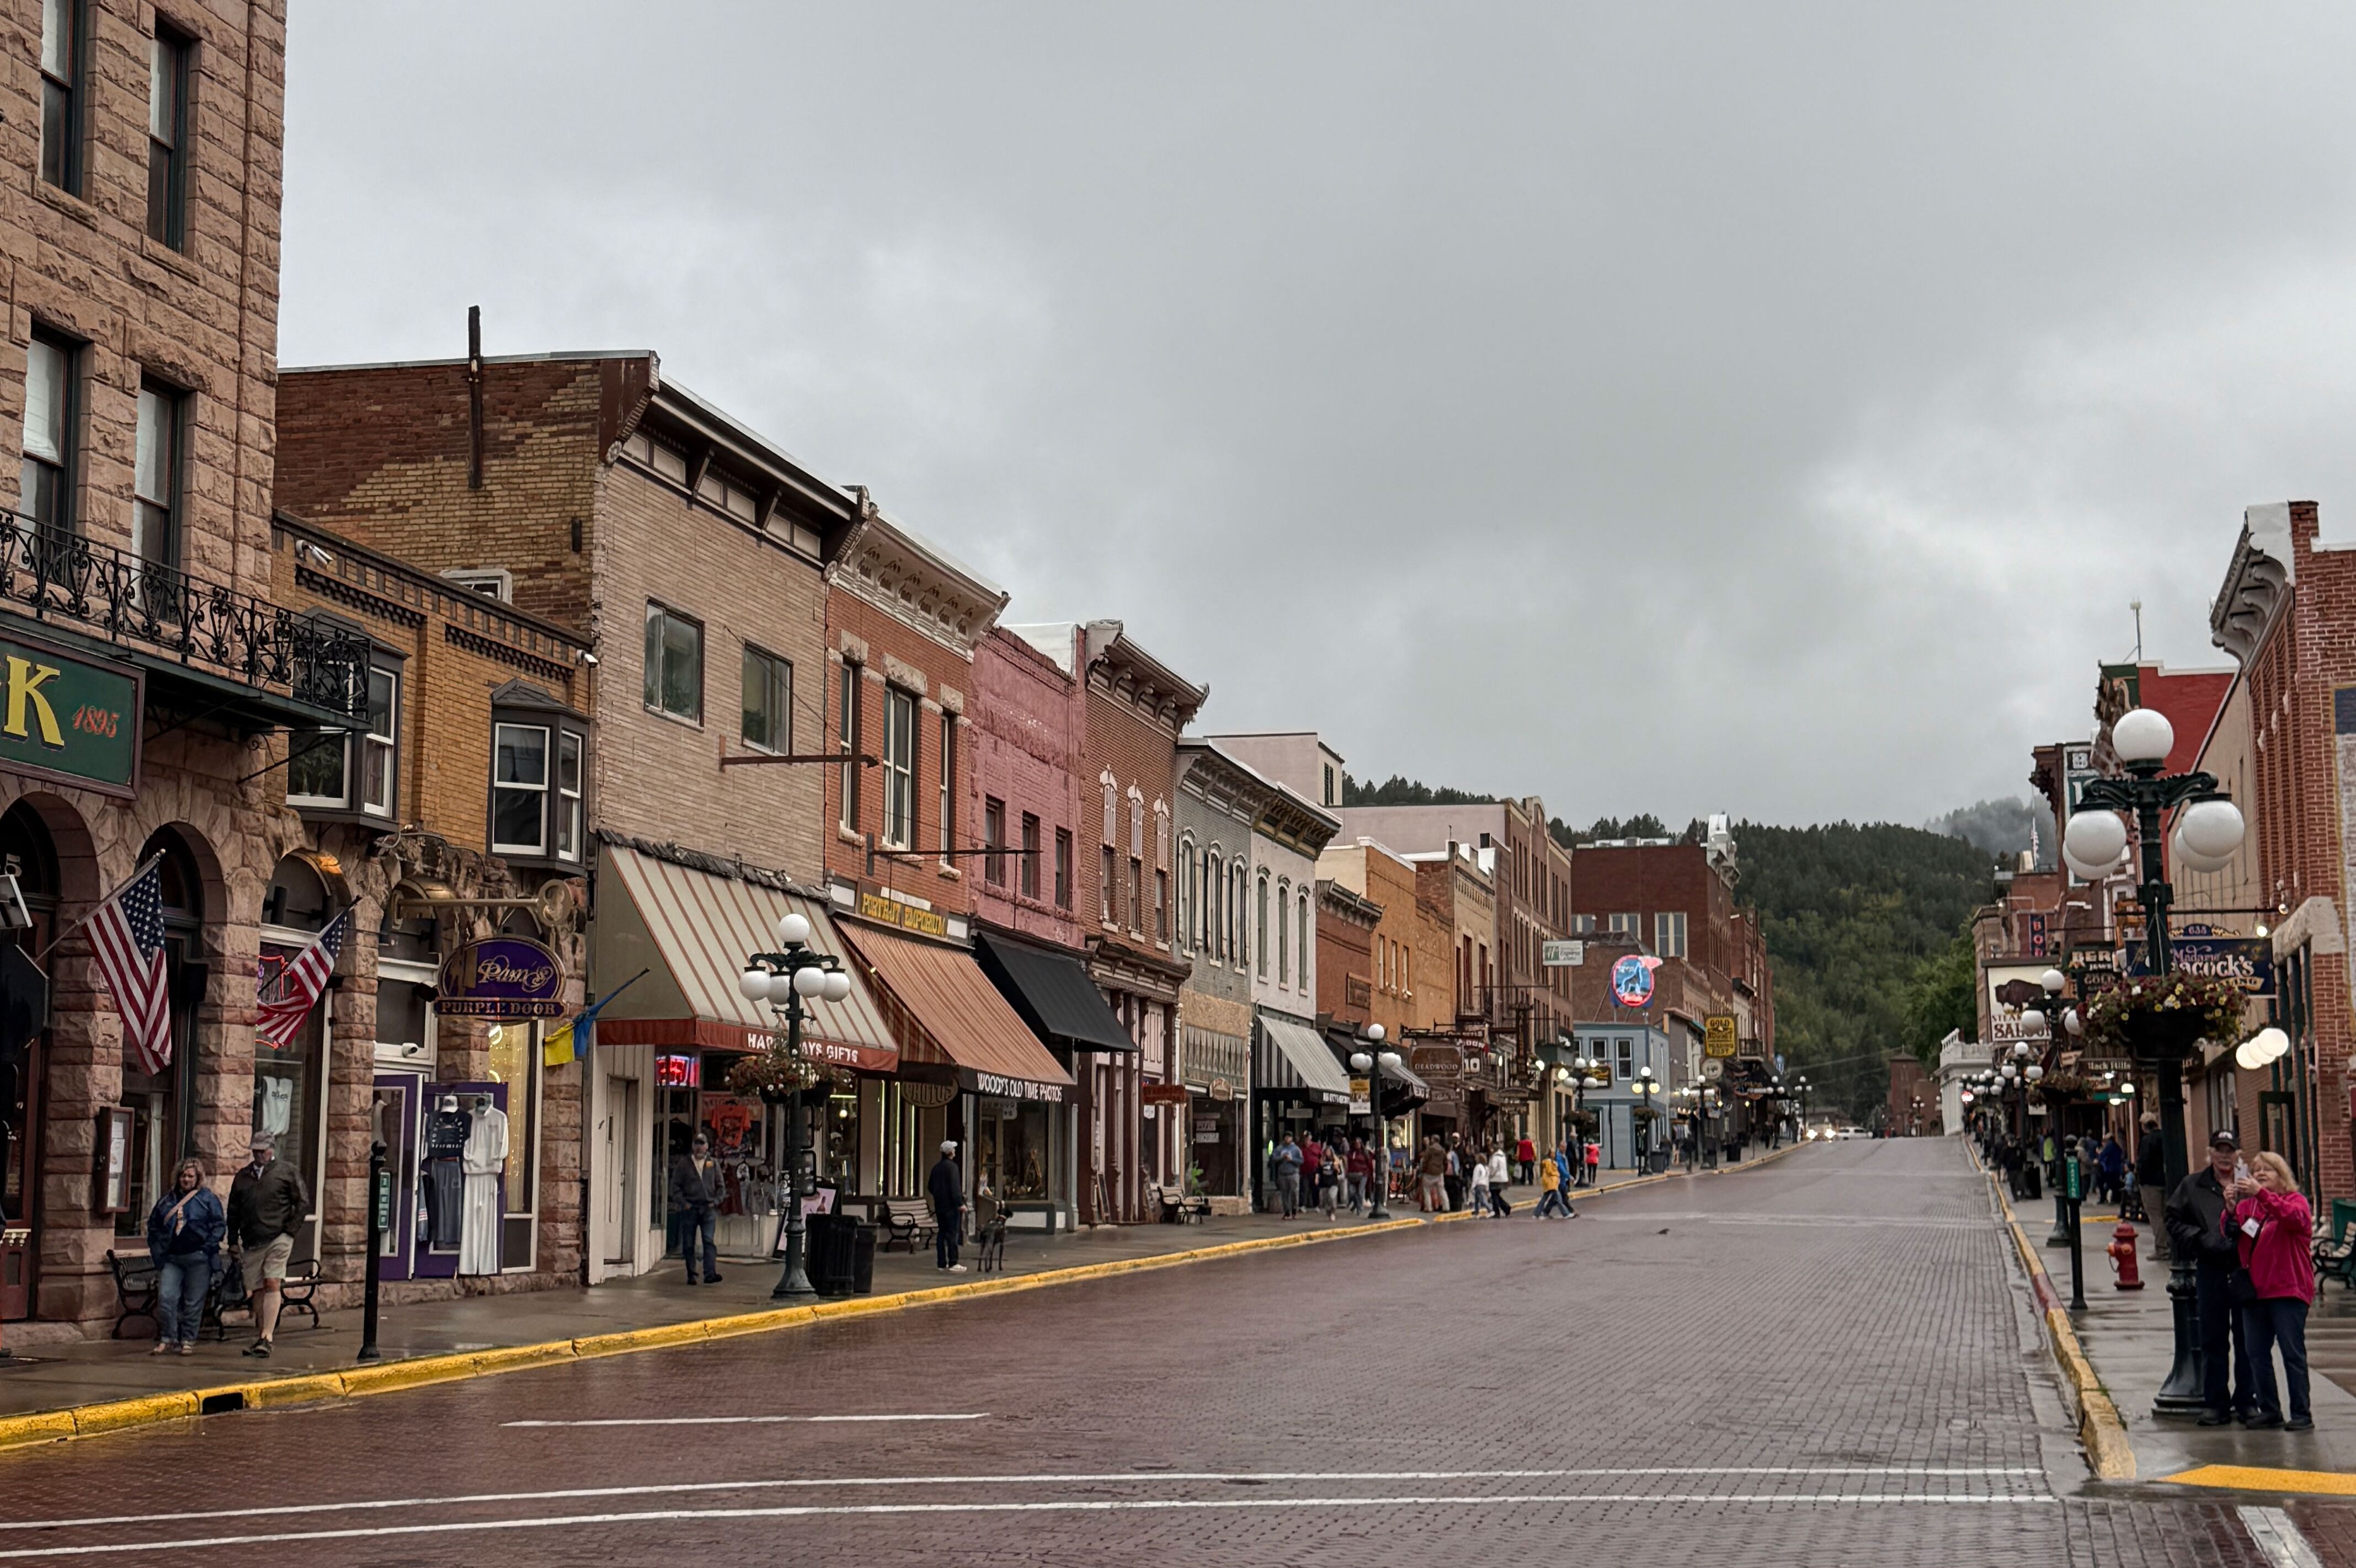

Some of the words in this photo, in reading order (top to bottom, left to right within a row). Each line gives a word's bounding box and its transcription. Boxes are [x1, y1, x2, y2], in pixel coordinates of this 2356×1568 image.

[72, 705, 120, 738] 1895
[862, 893, 901, 925] PORTRAIT
[904, 906, 946, 937] EMPORIUM
[441, 1002, 506, 1014] PURPLE
[510, 1002, 556, 1014] DOOR
[827, 1044, 859, 1063] GIFTS
[1463, 1058, 1480, 1073] 10
[977, 1073, 1009, 1096] WOODY'S
[1009, 1079, 1024, 1097] OLD
[1024, 1081, 1039, 1100] TIME
[1039, 1083, 1063, 1103] PHOTOS
